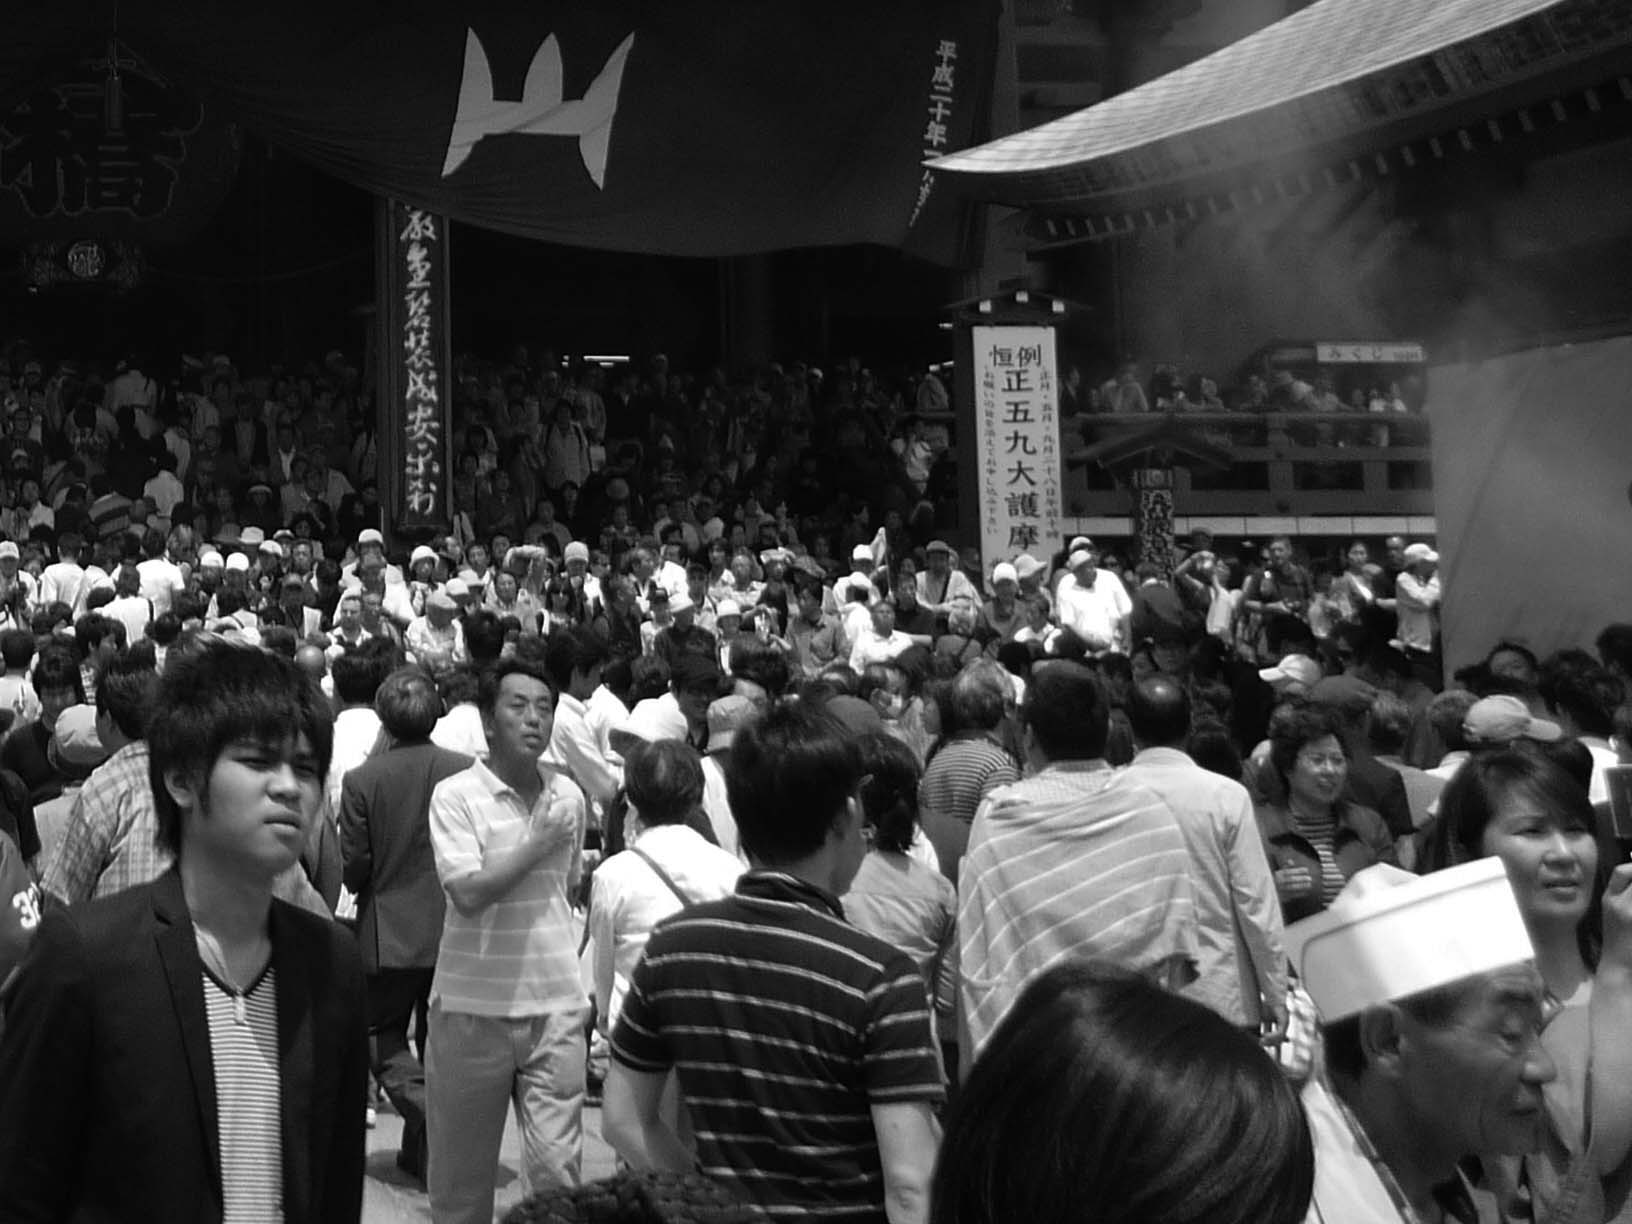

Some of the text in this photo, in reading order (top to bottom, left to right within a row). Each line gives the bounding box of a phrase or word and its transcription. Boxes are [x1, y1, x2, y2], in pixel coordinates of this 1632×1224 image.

[989, 344, 1042, 368] 恒例
[1001, 369, 1042, 558] 正五九大護摩
